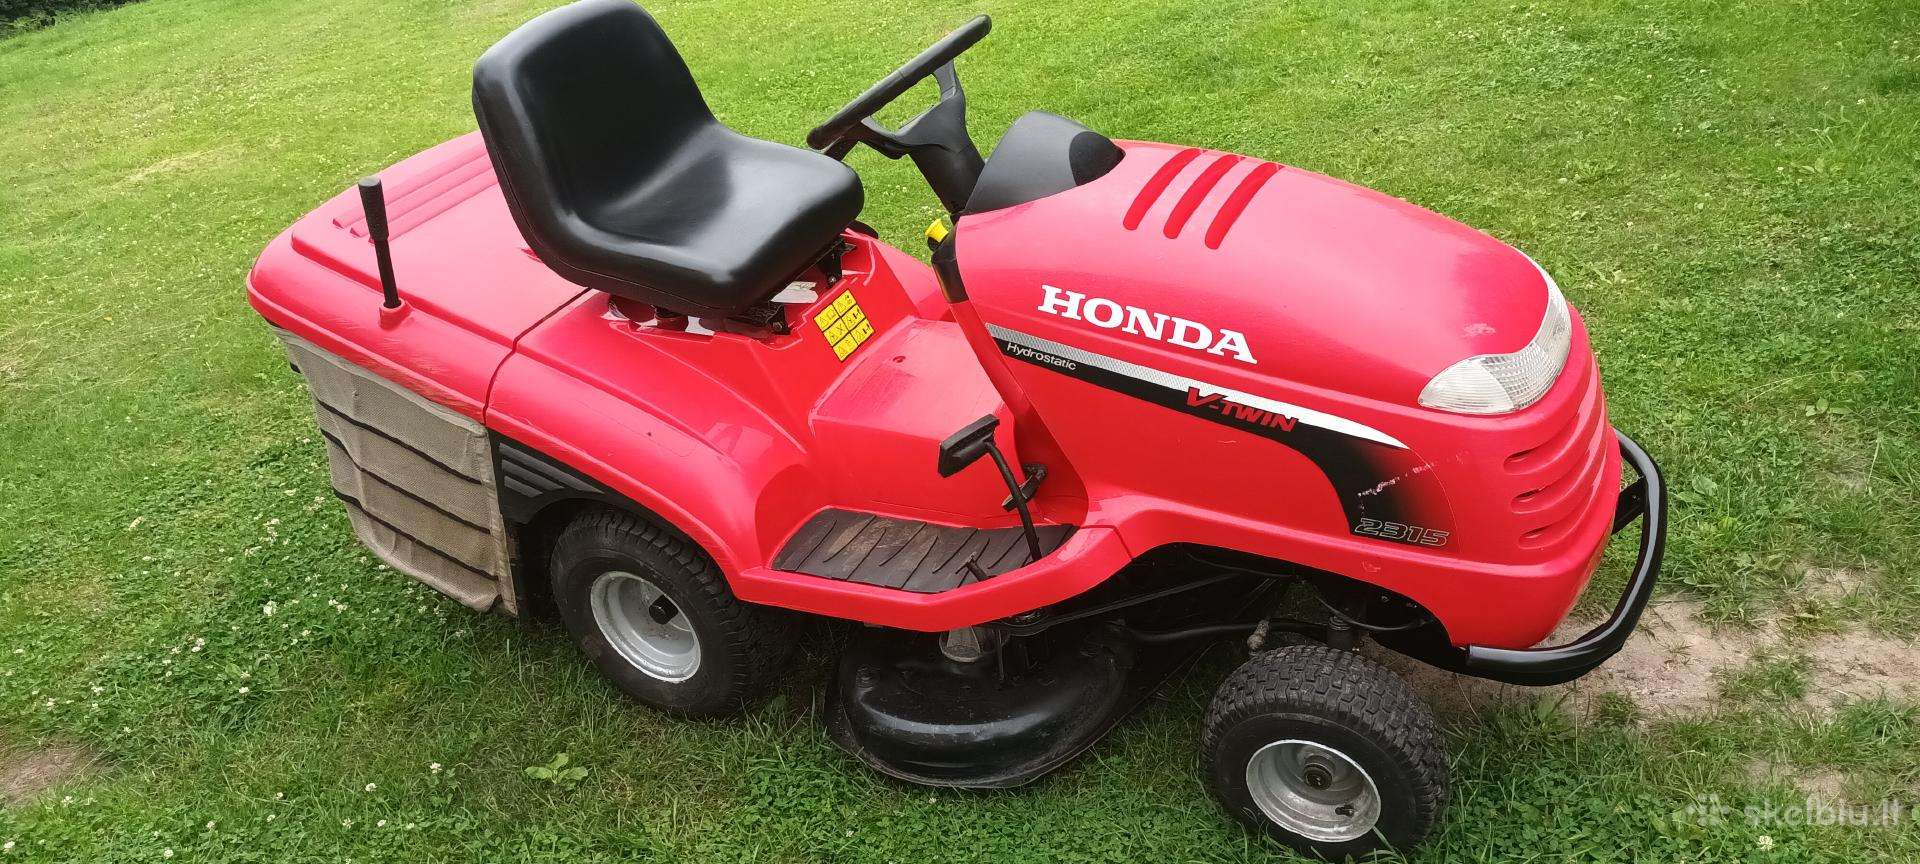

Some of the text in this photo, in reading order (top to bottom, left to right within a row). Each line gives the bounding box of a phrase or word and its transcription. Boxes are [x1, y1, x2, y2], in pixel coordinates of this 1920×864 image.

[1037, 284, 1257, 365] HONDA
[1006, 341, 1077, 371] Hydrostatic
[1186, 386, 1299, 433] V-TWIN
[1354, 517, 1449, 548] 2315
